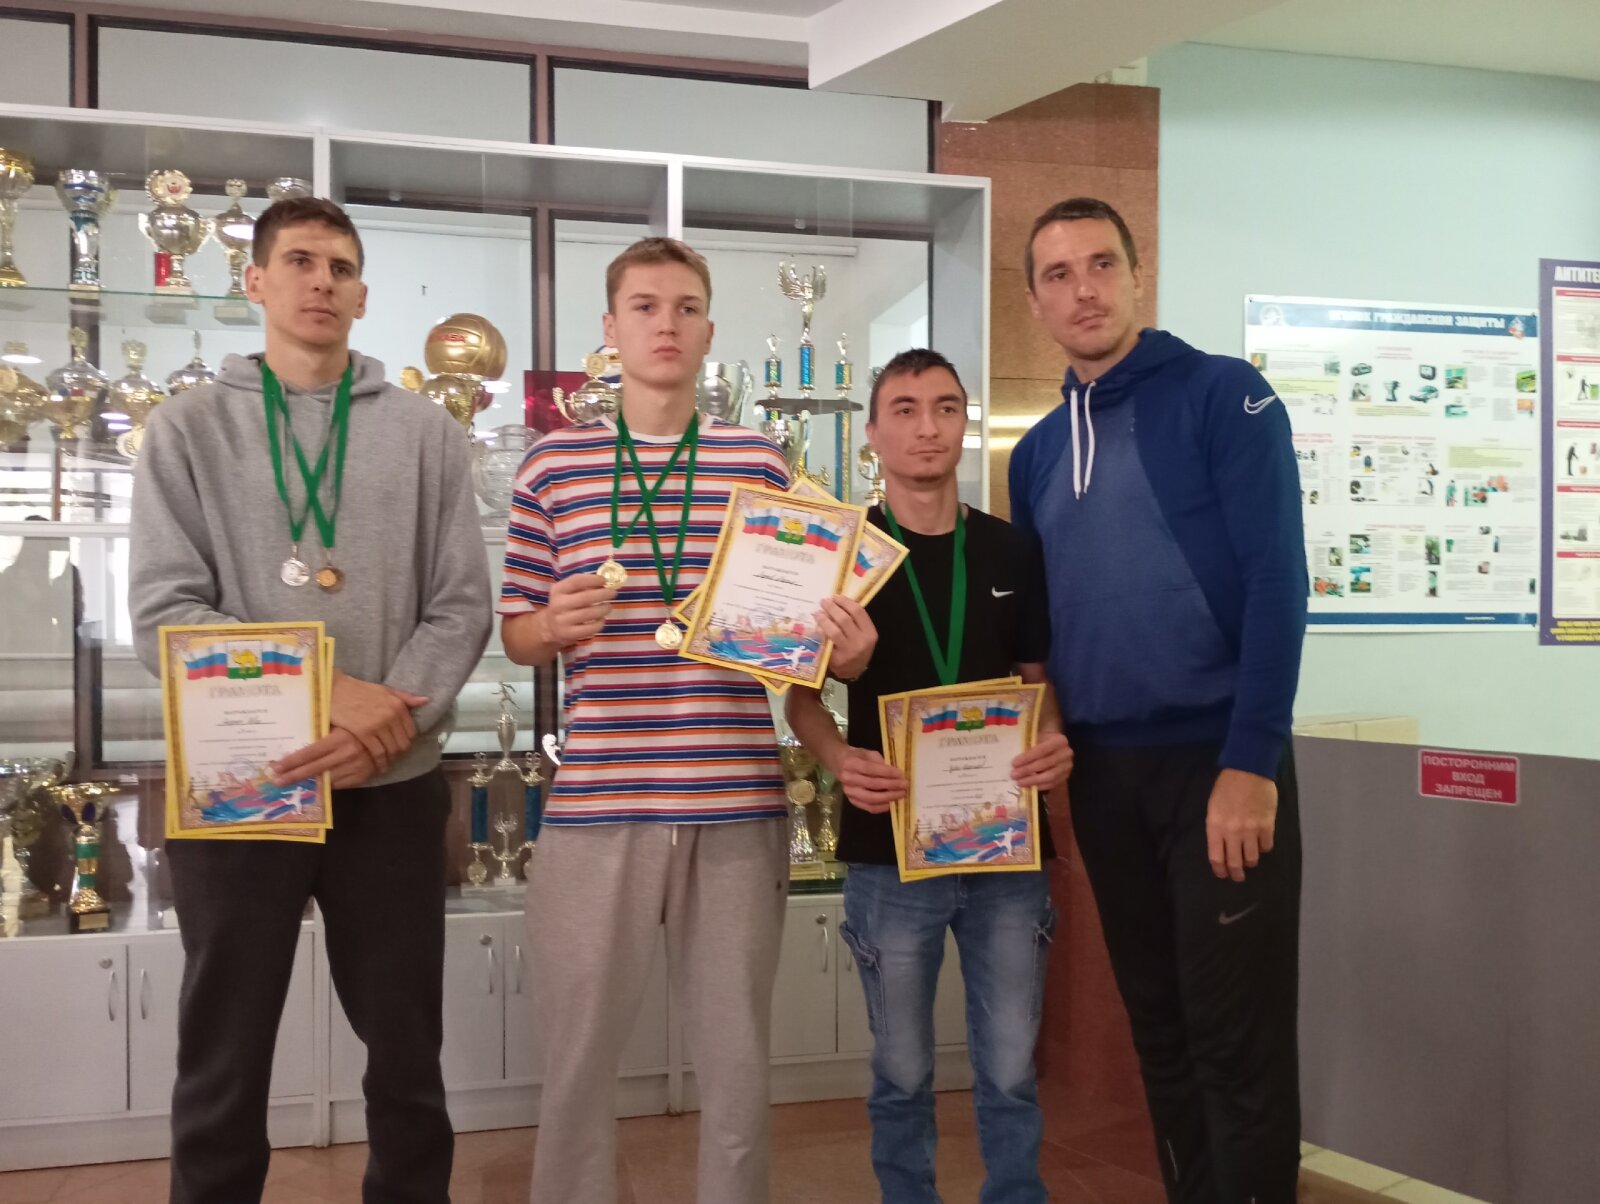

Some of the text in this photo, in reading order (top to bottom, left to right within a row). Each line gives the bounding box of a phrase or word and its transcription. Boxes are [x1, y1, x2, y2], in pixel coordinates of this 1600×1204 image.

[1423, 755, 1515, 771] ПОСТОРОННИМ
[1451, 772, 1485, 785] ВХОД
[1434, 784, 1502, 799] ЗАПРЕЩЕН
